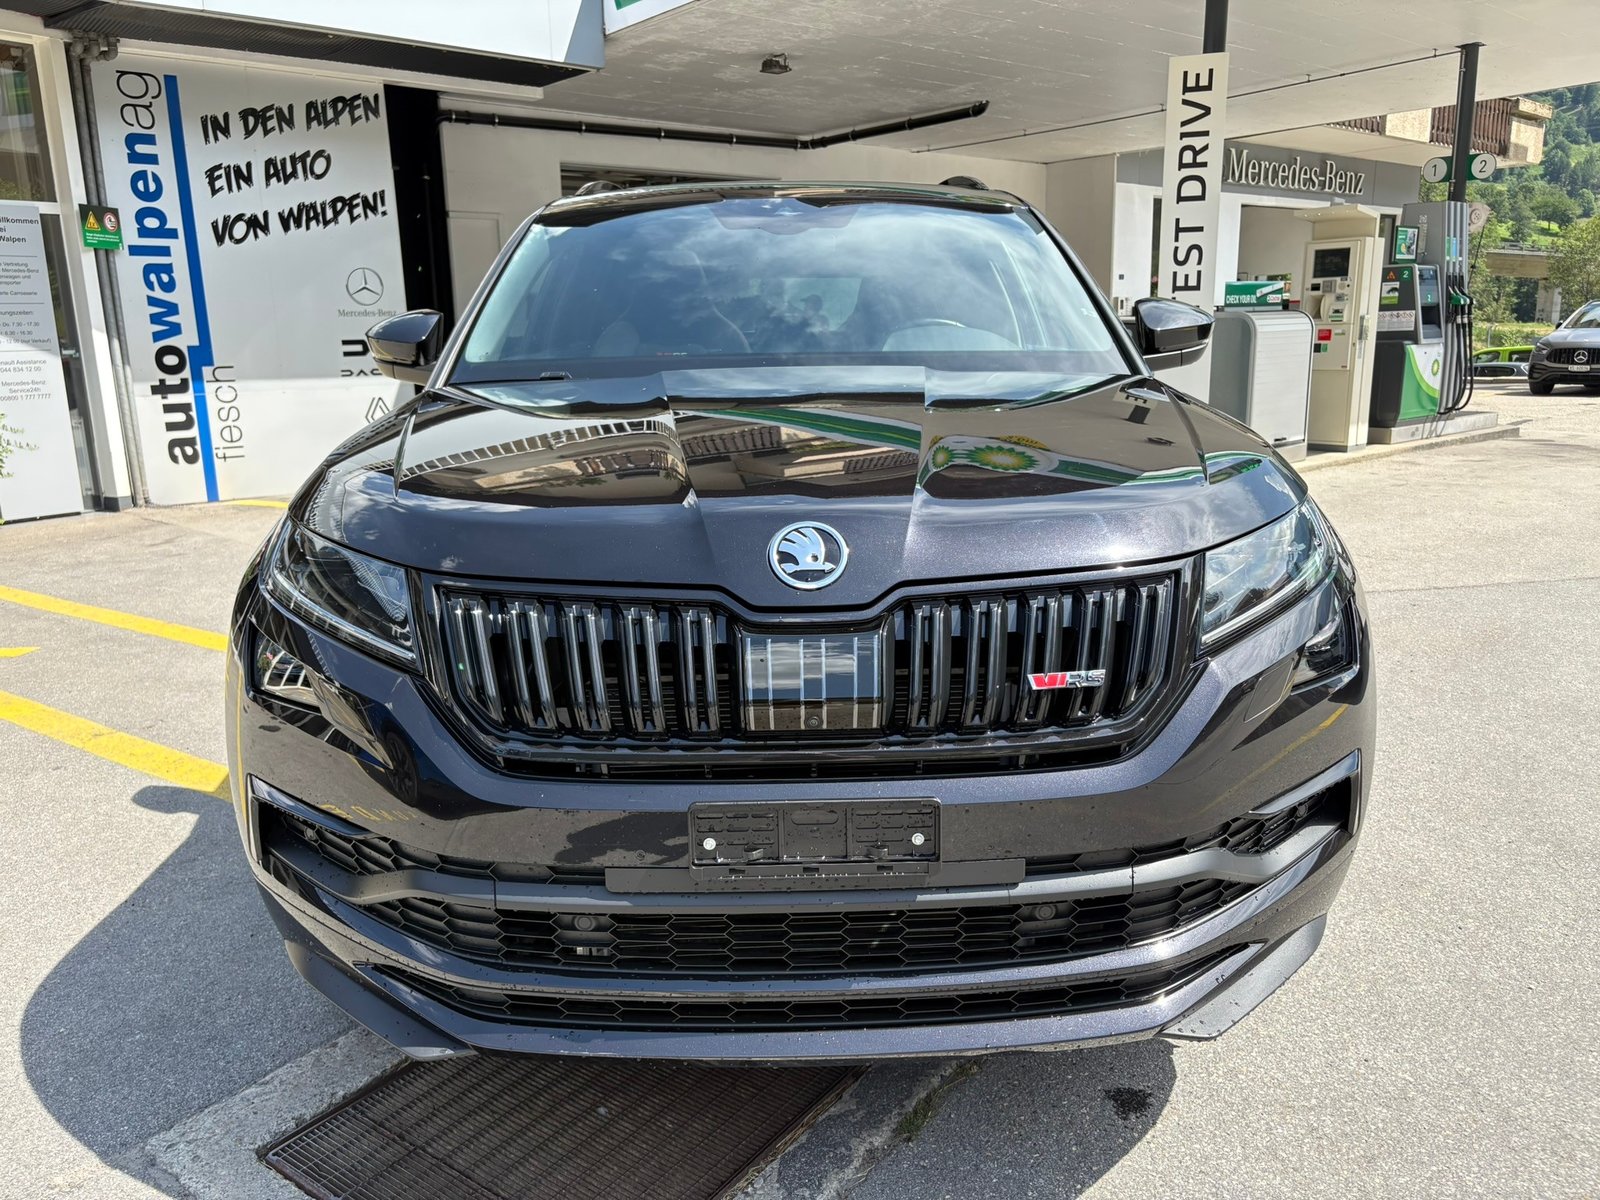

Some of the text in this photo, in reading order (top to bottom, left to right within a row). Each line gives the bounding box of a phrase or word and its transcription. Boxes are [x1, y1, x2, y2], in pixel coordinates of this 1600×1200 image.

[200, 93, 381, 145] IN DEN ALPEN
[205, 149, 332, 198] EIN AUTO
[1227, 147, 1366, 196] Mercedes-Benz
[1431, 163, 1437, 177] 1
[1478, 159, 1487, 173] 2
[1171, 67, 1214, 301] EST DRIVE
[0, 216, 39, 225] illkommen
[211, 189, 388, 247] VON WALPEN!
[1403, 270, 1409, 278] 2
[337, 309, 397, 318] Mercedes-Benz
[340, 368, 384, 378] DAC
[206, 365, 245, 463] fiesch
